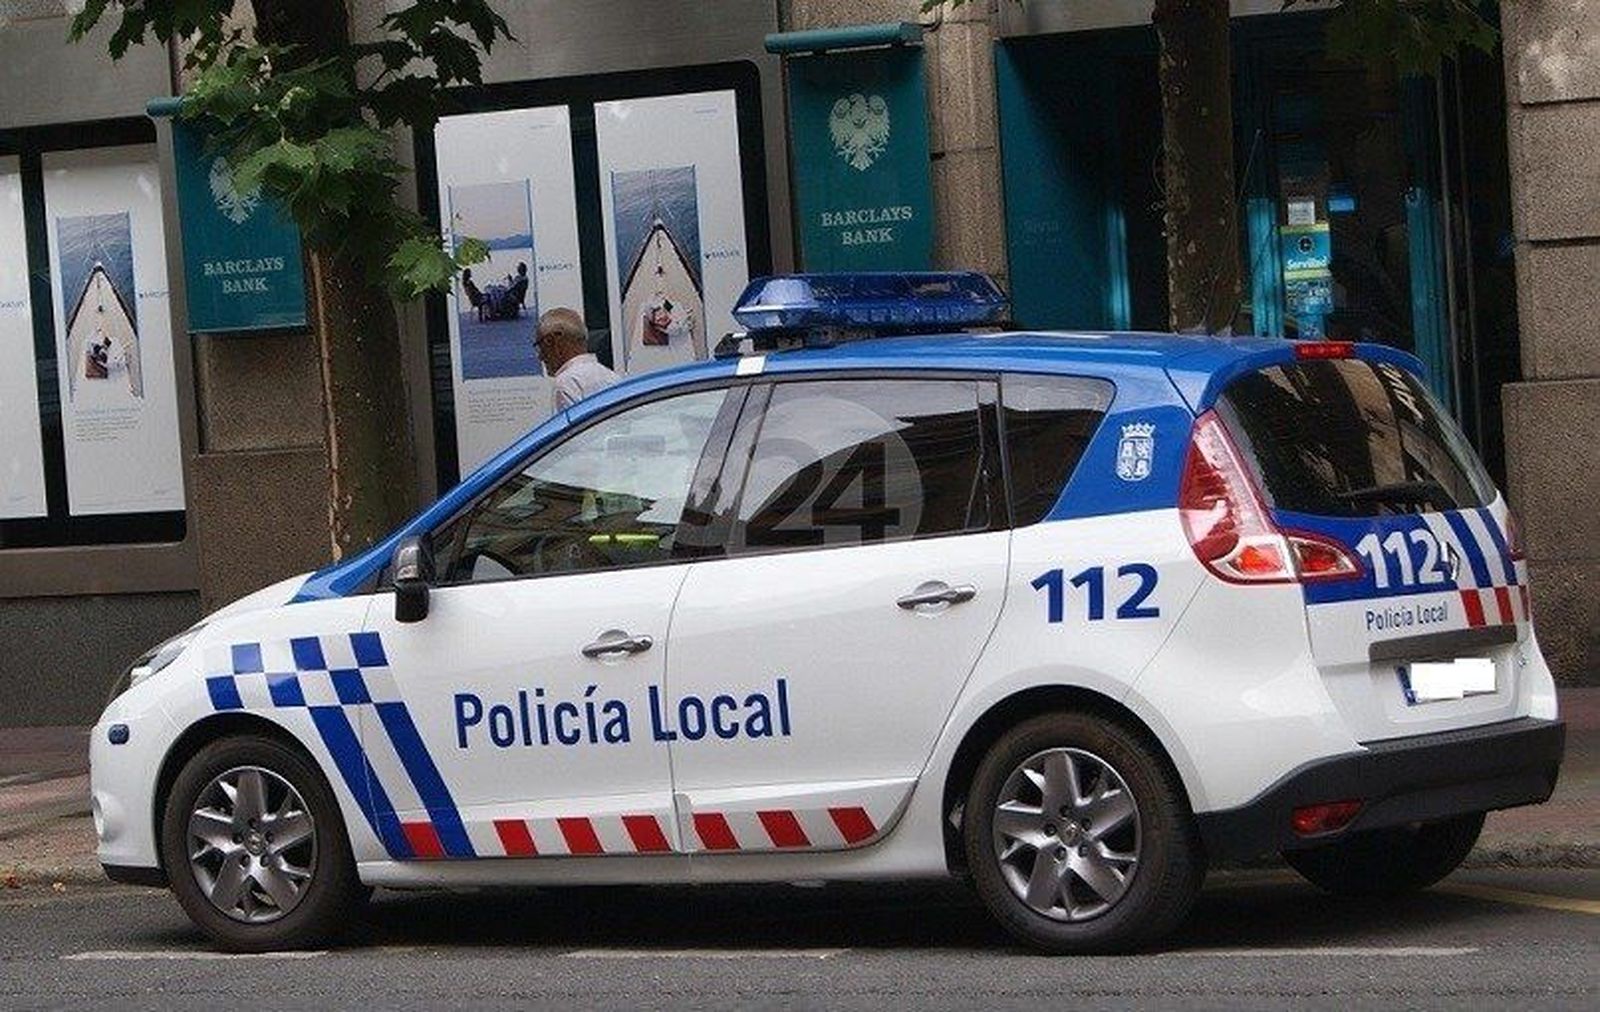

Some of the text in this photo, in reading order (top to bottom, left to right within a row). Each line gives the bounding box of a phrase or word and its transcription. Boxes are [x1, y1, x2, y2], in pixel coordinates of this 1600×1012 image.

[821, 205, 913, 226] BARCLAYS
[841, 227, 893, 246] BANK
[203, 256, 284, 276] BARCLAYS
[222, 277, 269, 295] BANK
[1355, 529, 1444, 589] 112
[1030, 563, 1161, 624] 112
[1416, 601, 1448, 625] Local
[453, 677, 792, 749] Policía Local
